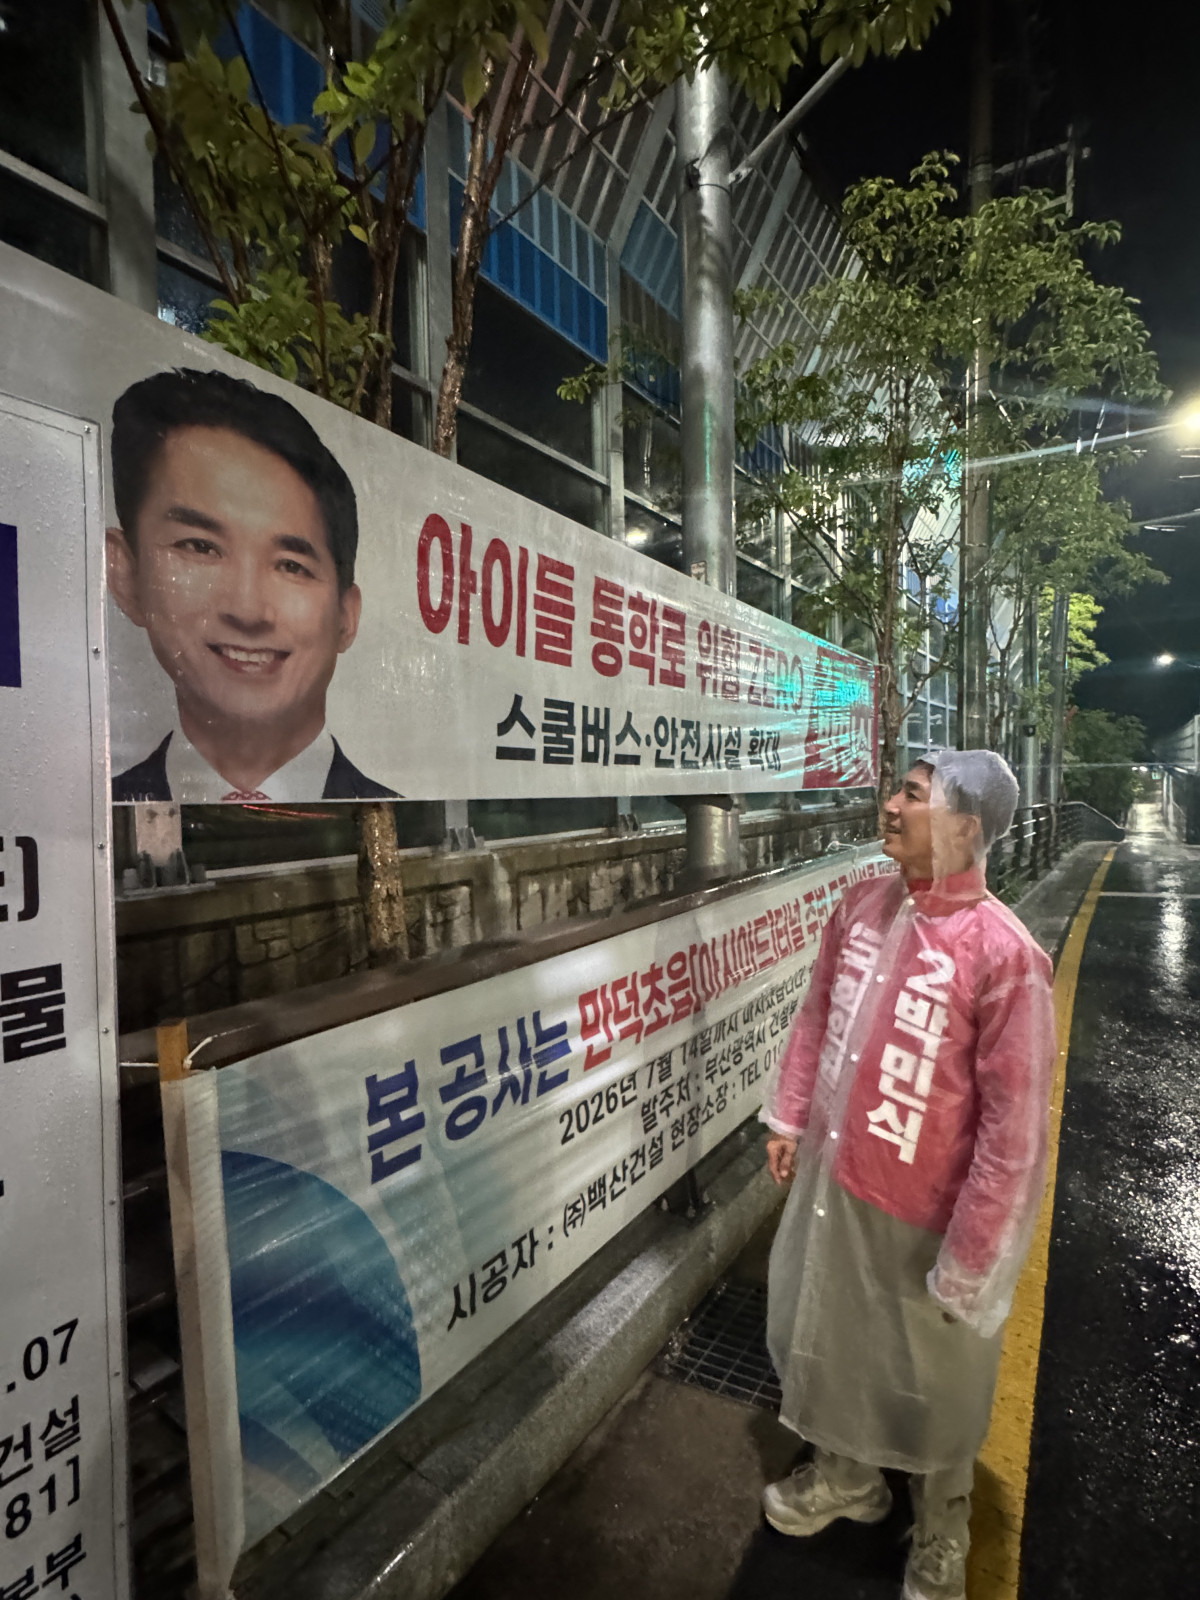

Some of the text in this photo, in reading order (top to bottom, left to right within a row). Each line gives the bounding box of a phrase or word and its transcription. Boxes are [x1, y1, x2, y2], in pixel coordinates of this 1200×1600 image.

[417, 513, 804, 713] 아이들 통학로 위험 ZERO
[496, 694, 780, 771] 스쿨버스·안전시설 확대
[365, 1060, 425, 1185] 본
[439, 1010, 572, 1141] 공사는
[559, 1072, 638, 1145] 2026년
[645, 1056, 672, 1092] 7월
[680, 1010, 739, 1066] 14일까지
[641, 1073, 691, 1133] 발주처
[705, 1021, 766, 1084] 부산광역시
[867, 949, 956, 1165] 2 박민식
[447, 1229, 539, 1331] 시공자
[562, 1133, 666, 1238] (주)백산건설
[670, 1081, 729, 1152] 현장소장
[740, 1059, 762, 1092] TEL
